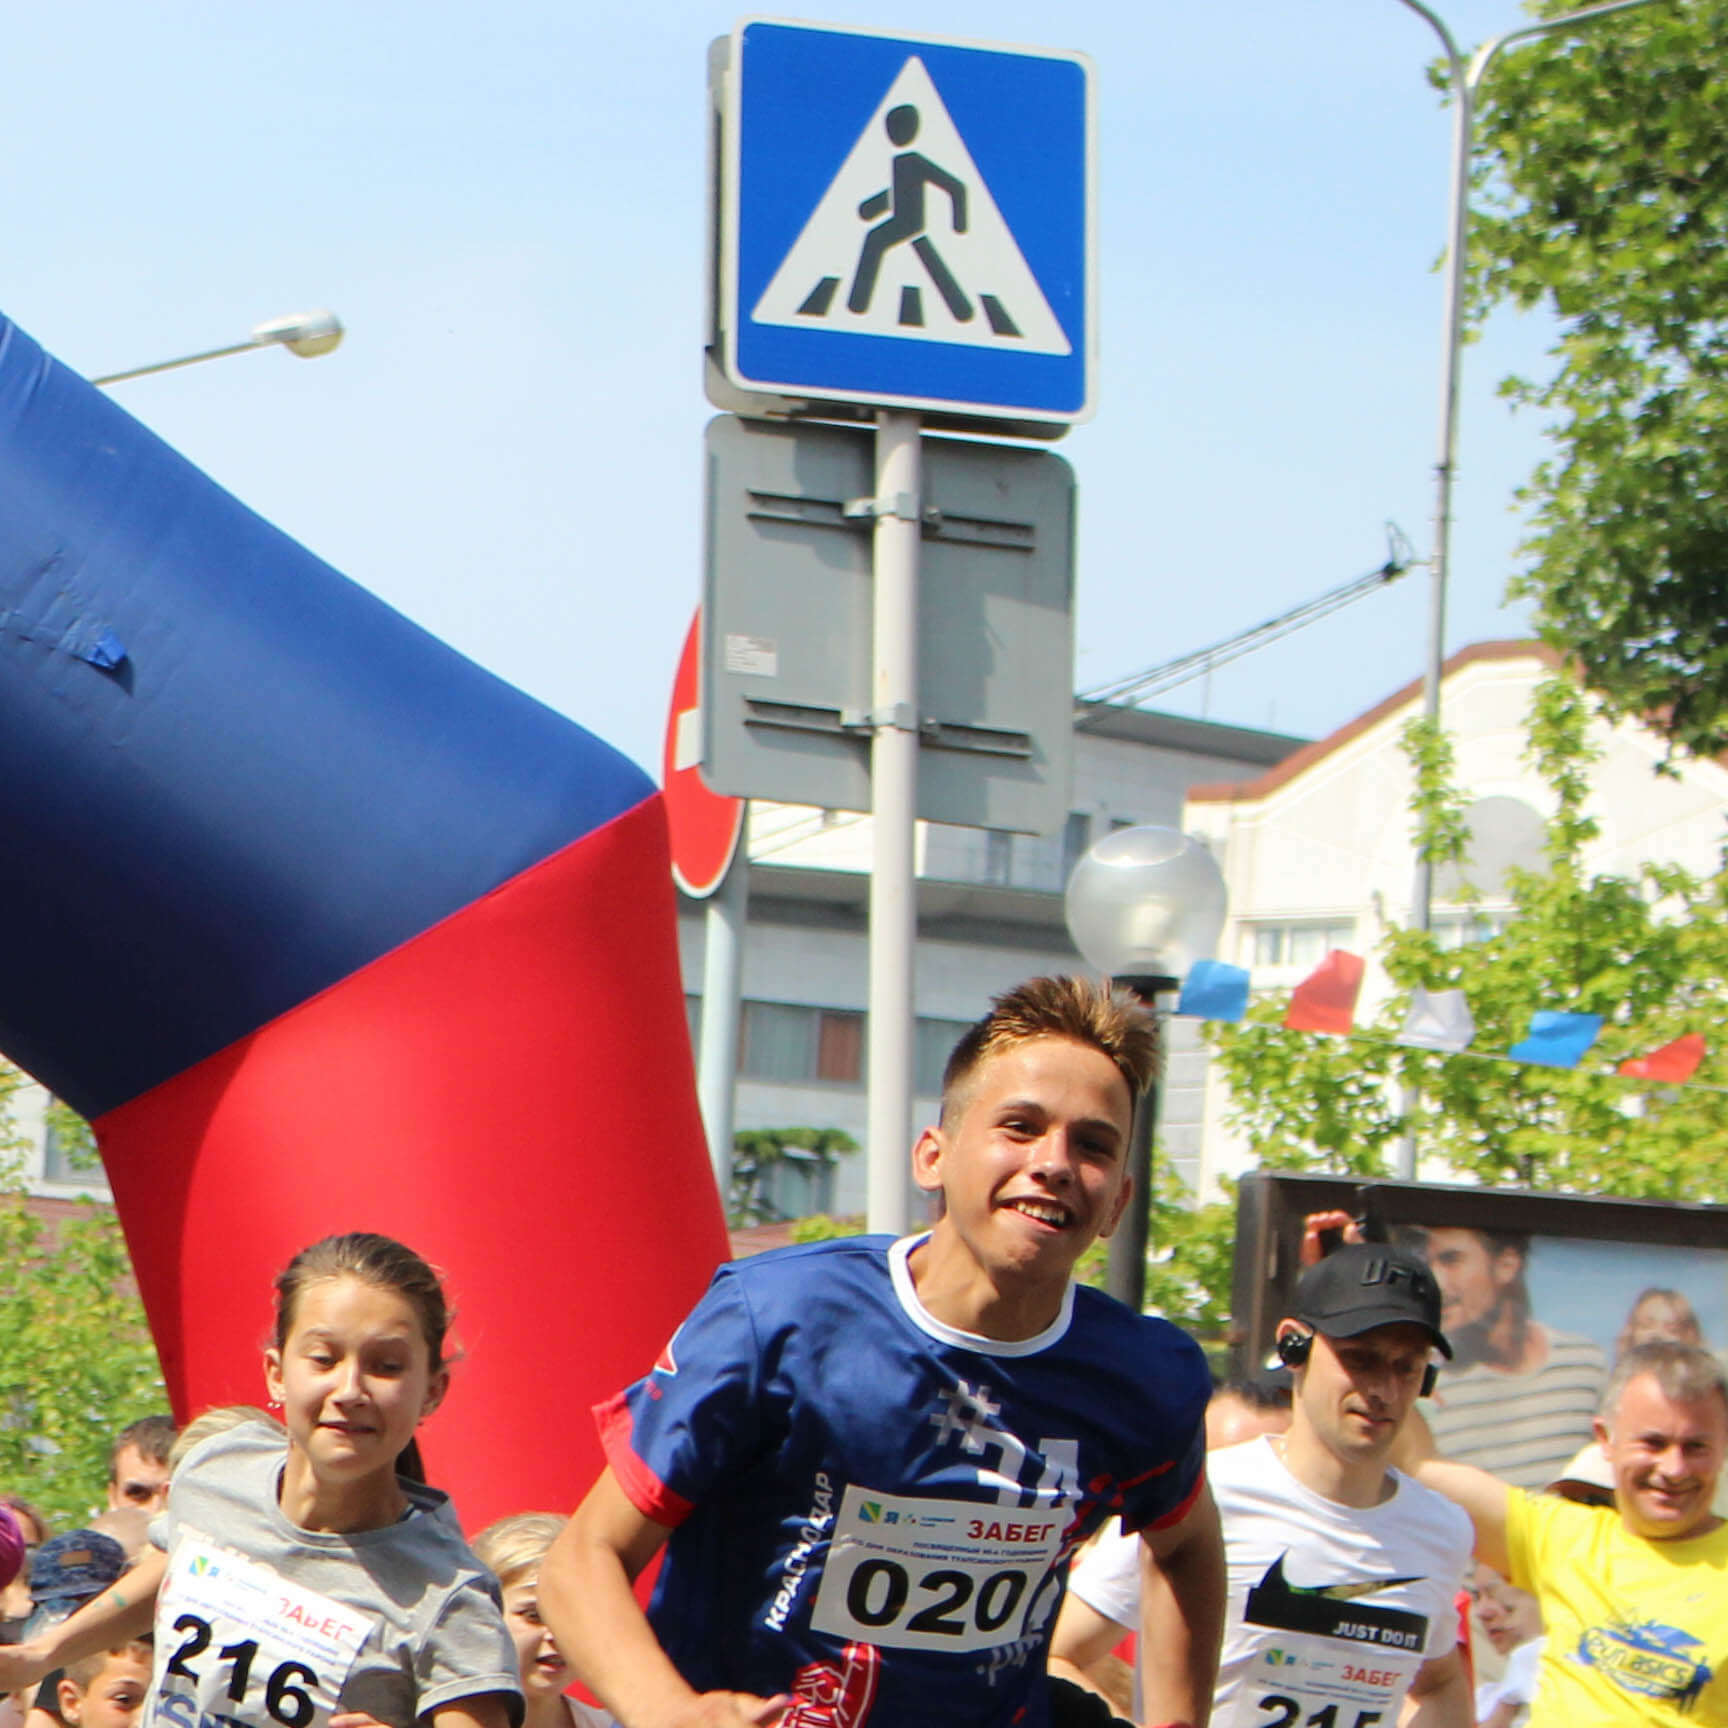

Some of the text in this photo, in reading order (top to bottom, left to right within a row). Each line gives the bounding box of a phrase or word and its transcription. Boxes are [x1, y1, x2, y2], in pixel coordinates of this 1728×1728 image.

[1359, 1258, 1428, 1296] UF
[967, 1519, 1057, 1544] ЗАБЕГ
[846, 1558, 1028, 1636] 020
[1333, 1621, 1420, 1649] JUST DO IT
[1340, 1664, 1403, 1688] ЗАБЕГ
